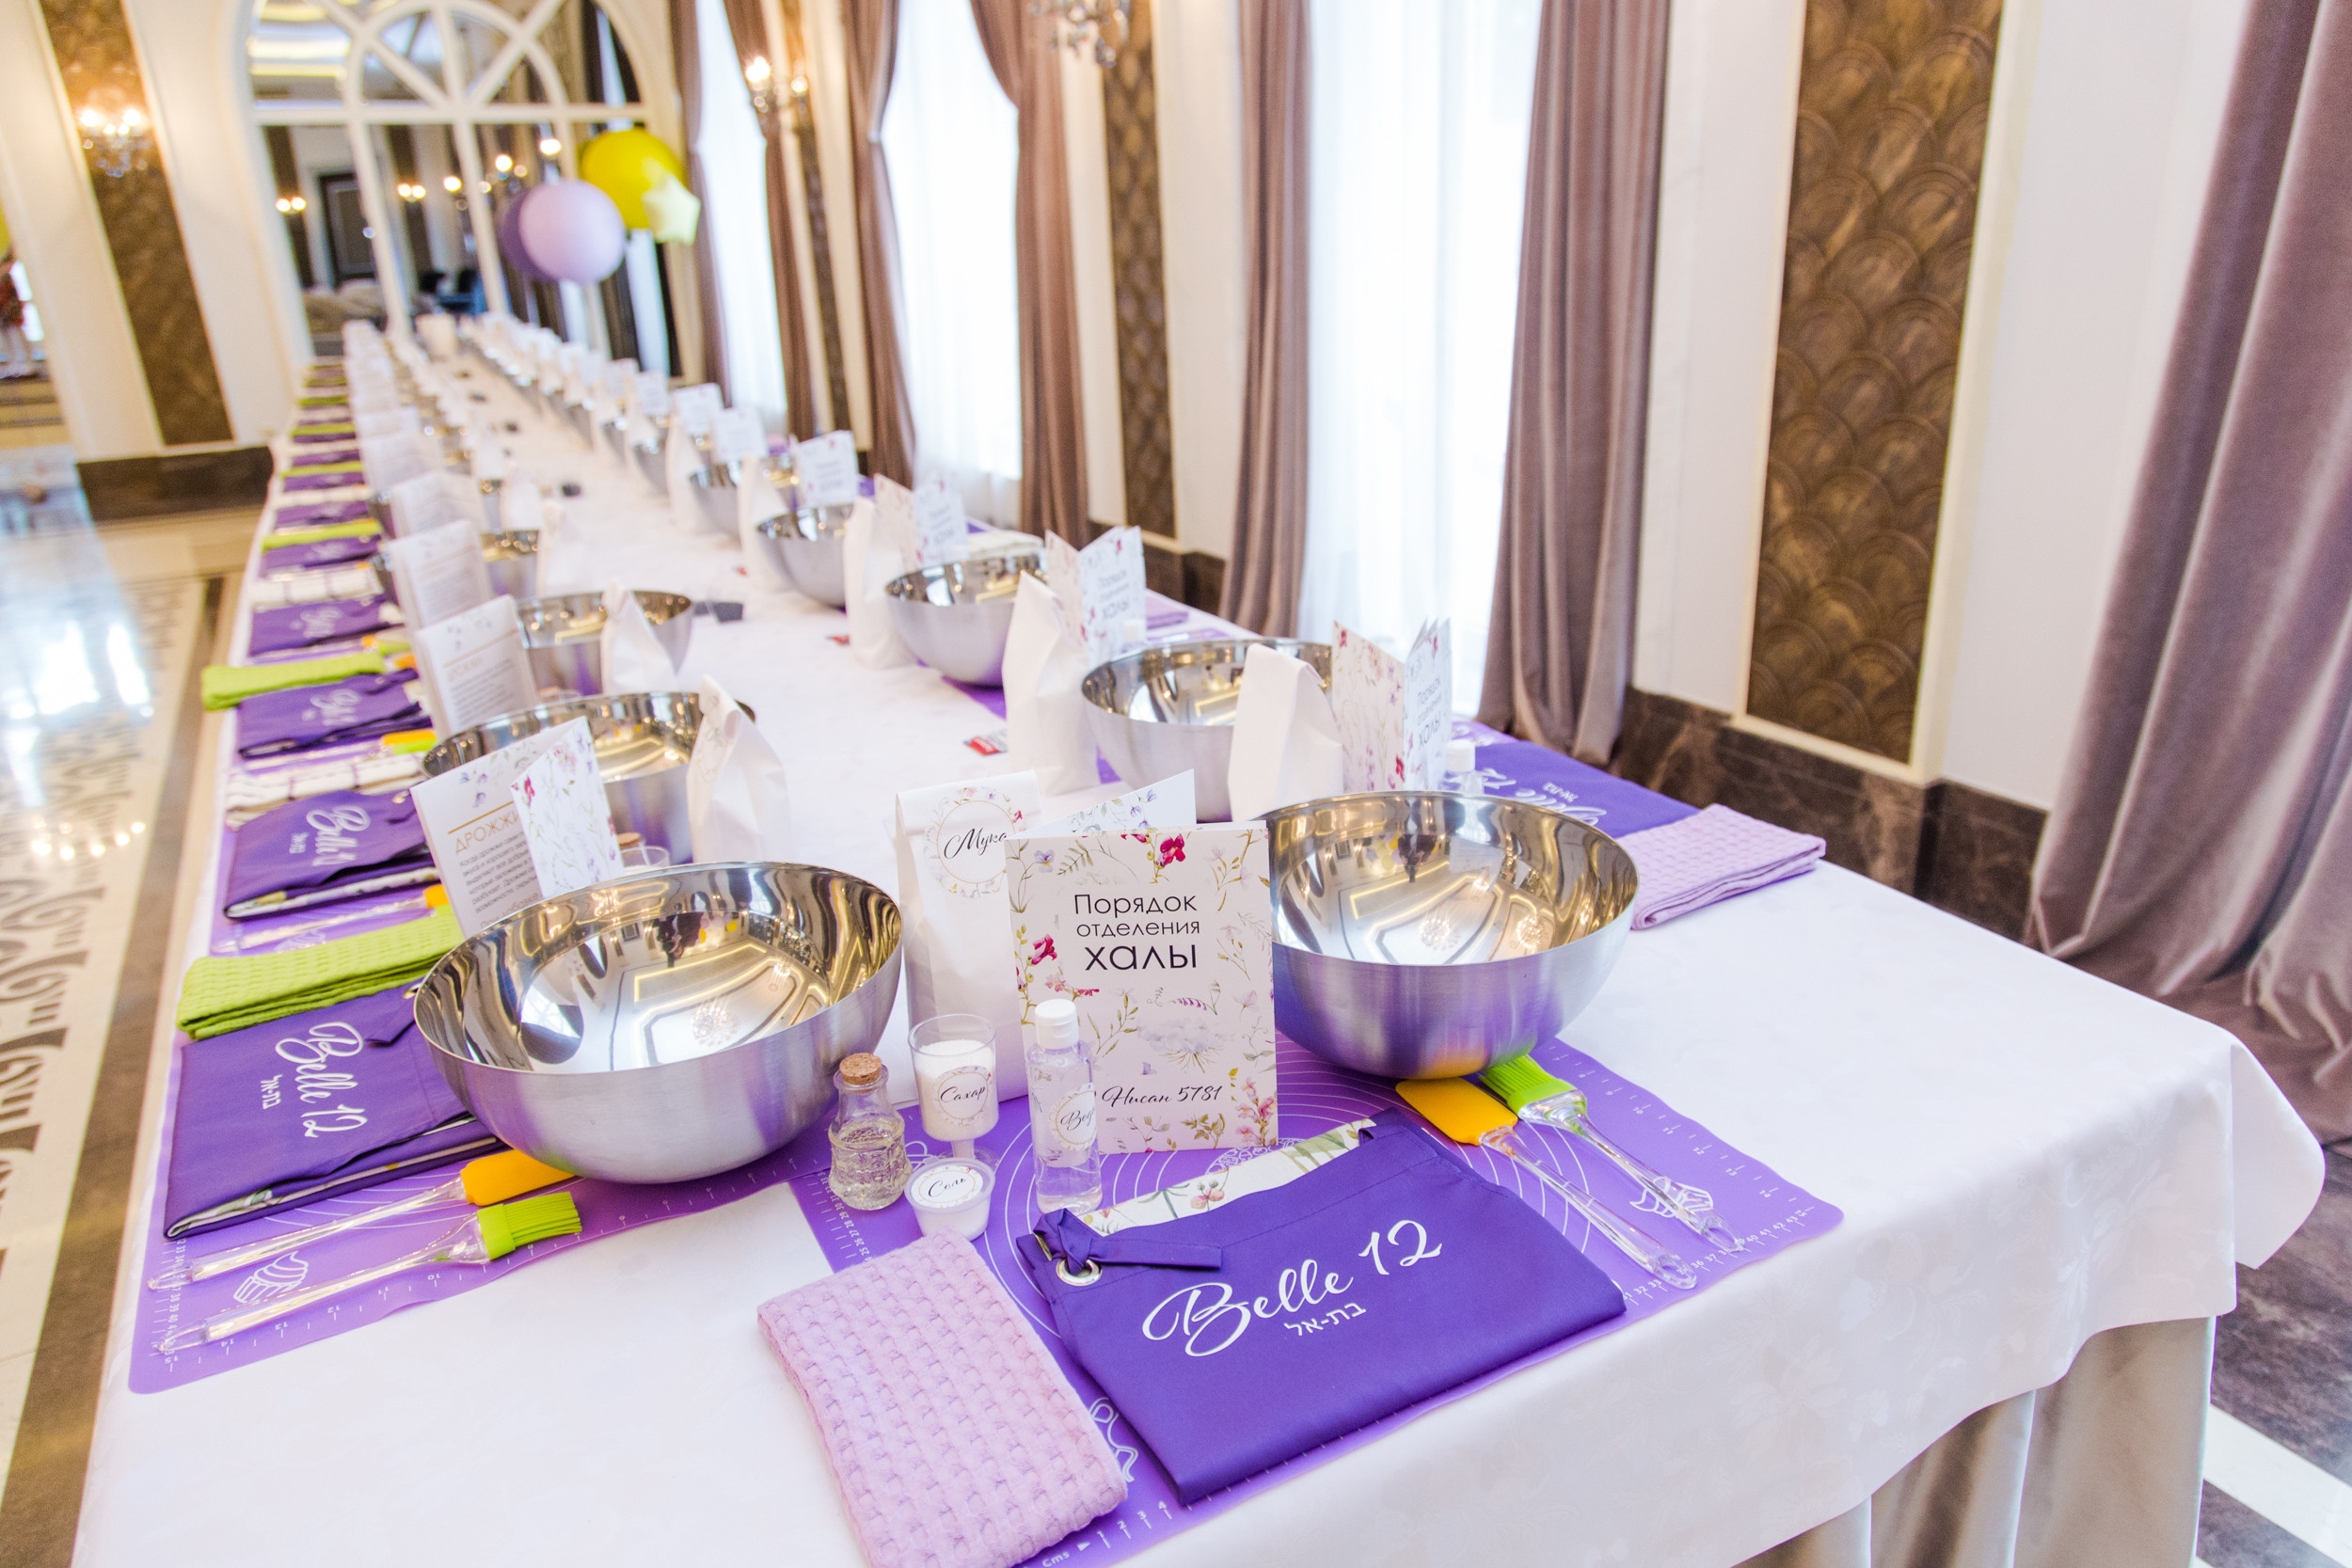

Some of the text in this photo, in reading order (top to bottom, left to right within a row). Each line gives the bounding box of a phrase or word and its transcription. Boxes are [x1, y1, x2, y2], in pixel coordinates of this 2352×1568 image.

[1074, 895, 1198, 918] Порядок
[1076, 920, 1200, 939] отделения
[1085, 944, 1198, 971] халы
[276, 1022, 368, 1138] Belle 12
[941, 1086, 986, 1102] Сахар
[1102, 1085, 1222, 1107] Нисан 5781
[1060, 1107, 1094, 1131] Вод
[1142, 1219, 1442, 1356] Belle 12
[1284, 1303, 1366, 1336] בת-אל
[1042, 1552, 1070, 1567] Cms
[1118, 1520, 1126, 1528] 2
[1137, 1511, 1147, 1520] 3
